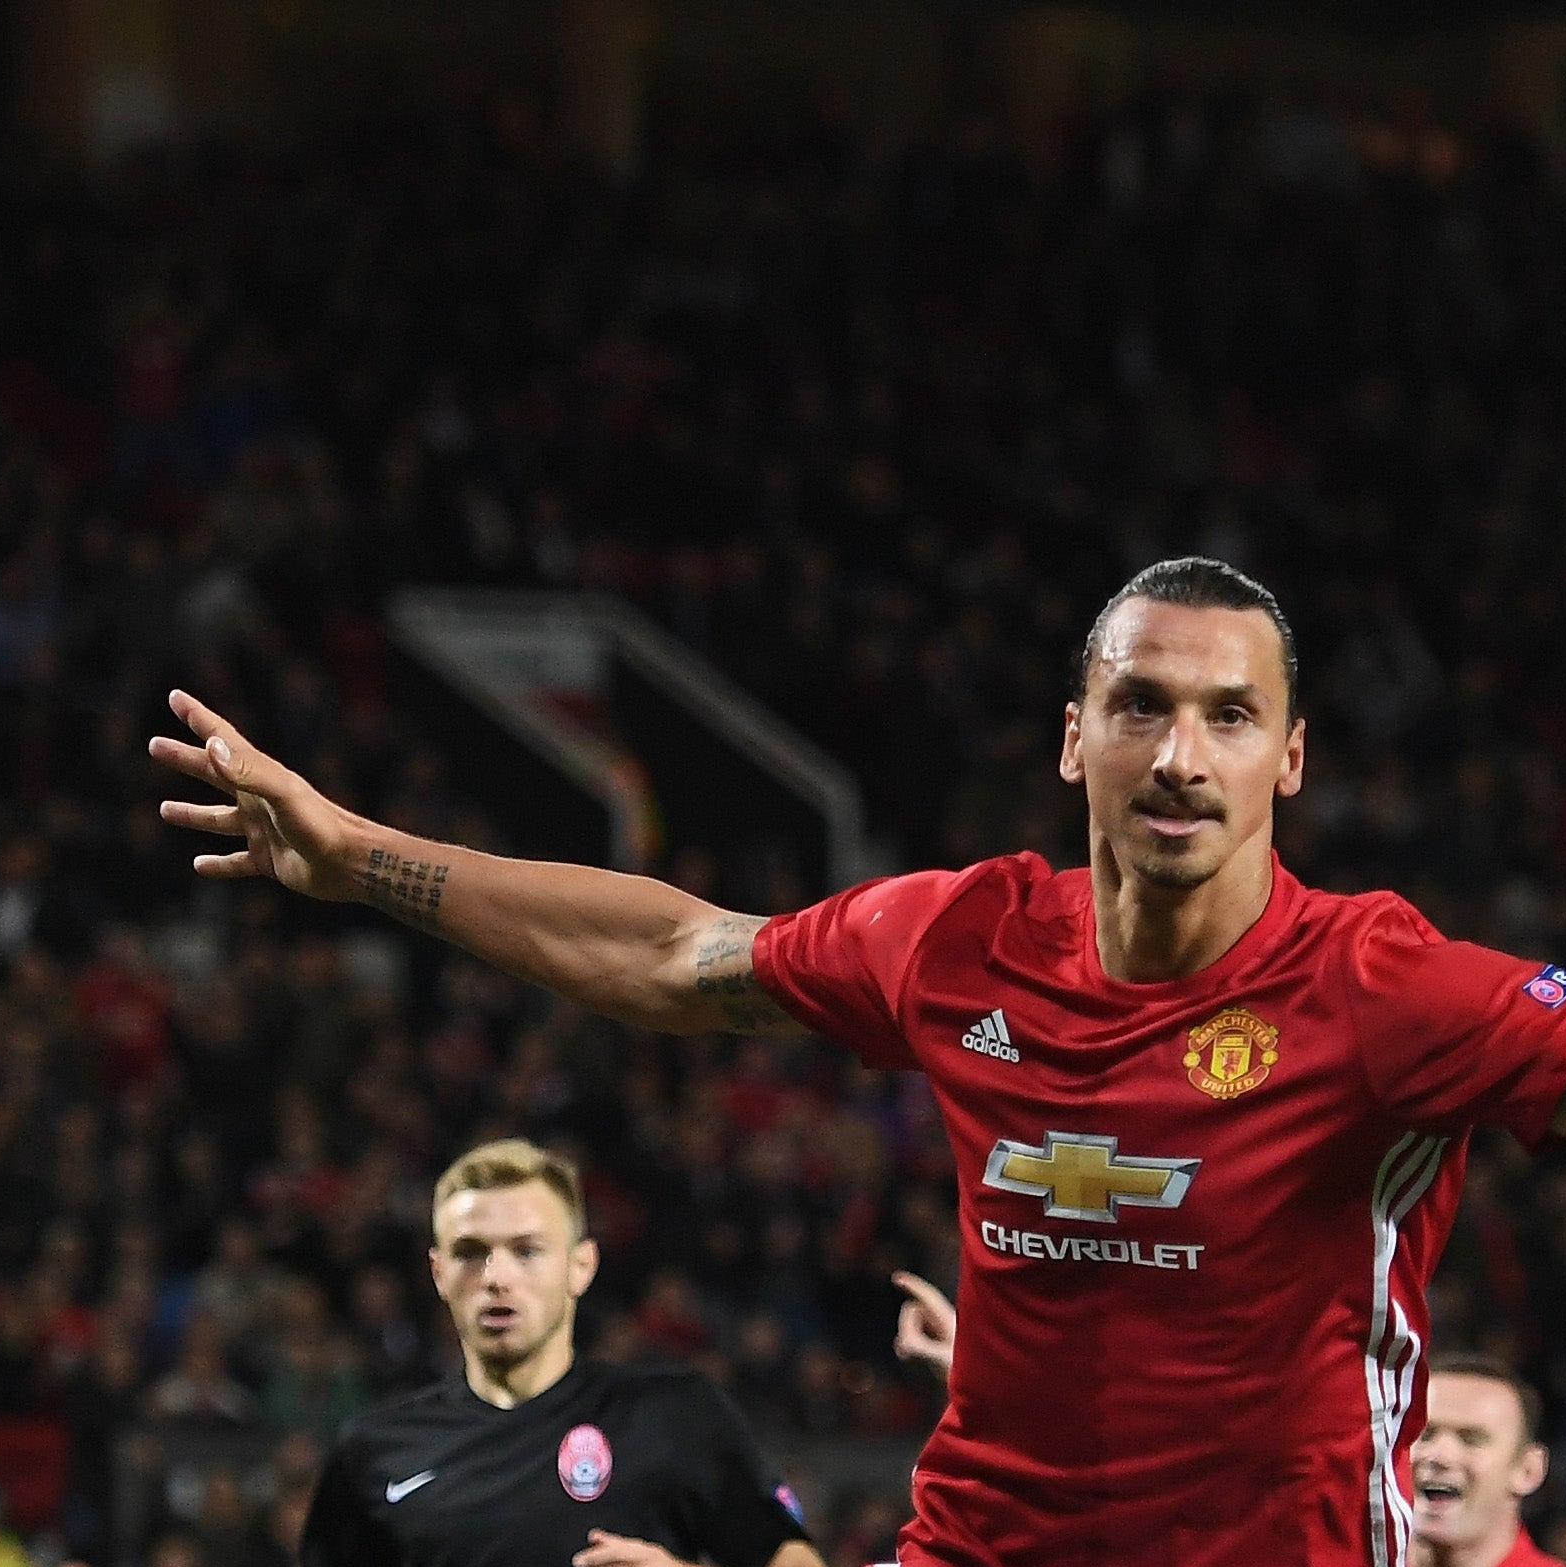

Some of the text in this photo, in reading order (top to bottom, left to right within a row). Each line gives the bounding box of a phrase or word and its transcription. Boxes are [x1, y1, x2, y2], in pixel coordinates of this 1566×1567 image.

[1194, 1015, 1271, 1046] MANCHESTER
[961, 1032, 1020, 1063] adidas
[1200, 1077, 1255, 1093] UNITED
[981, 1220, 1205, 1270] CHEVROLET
